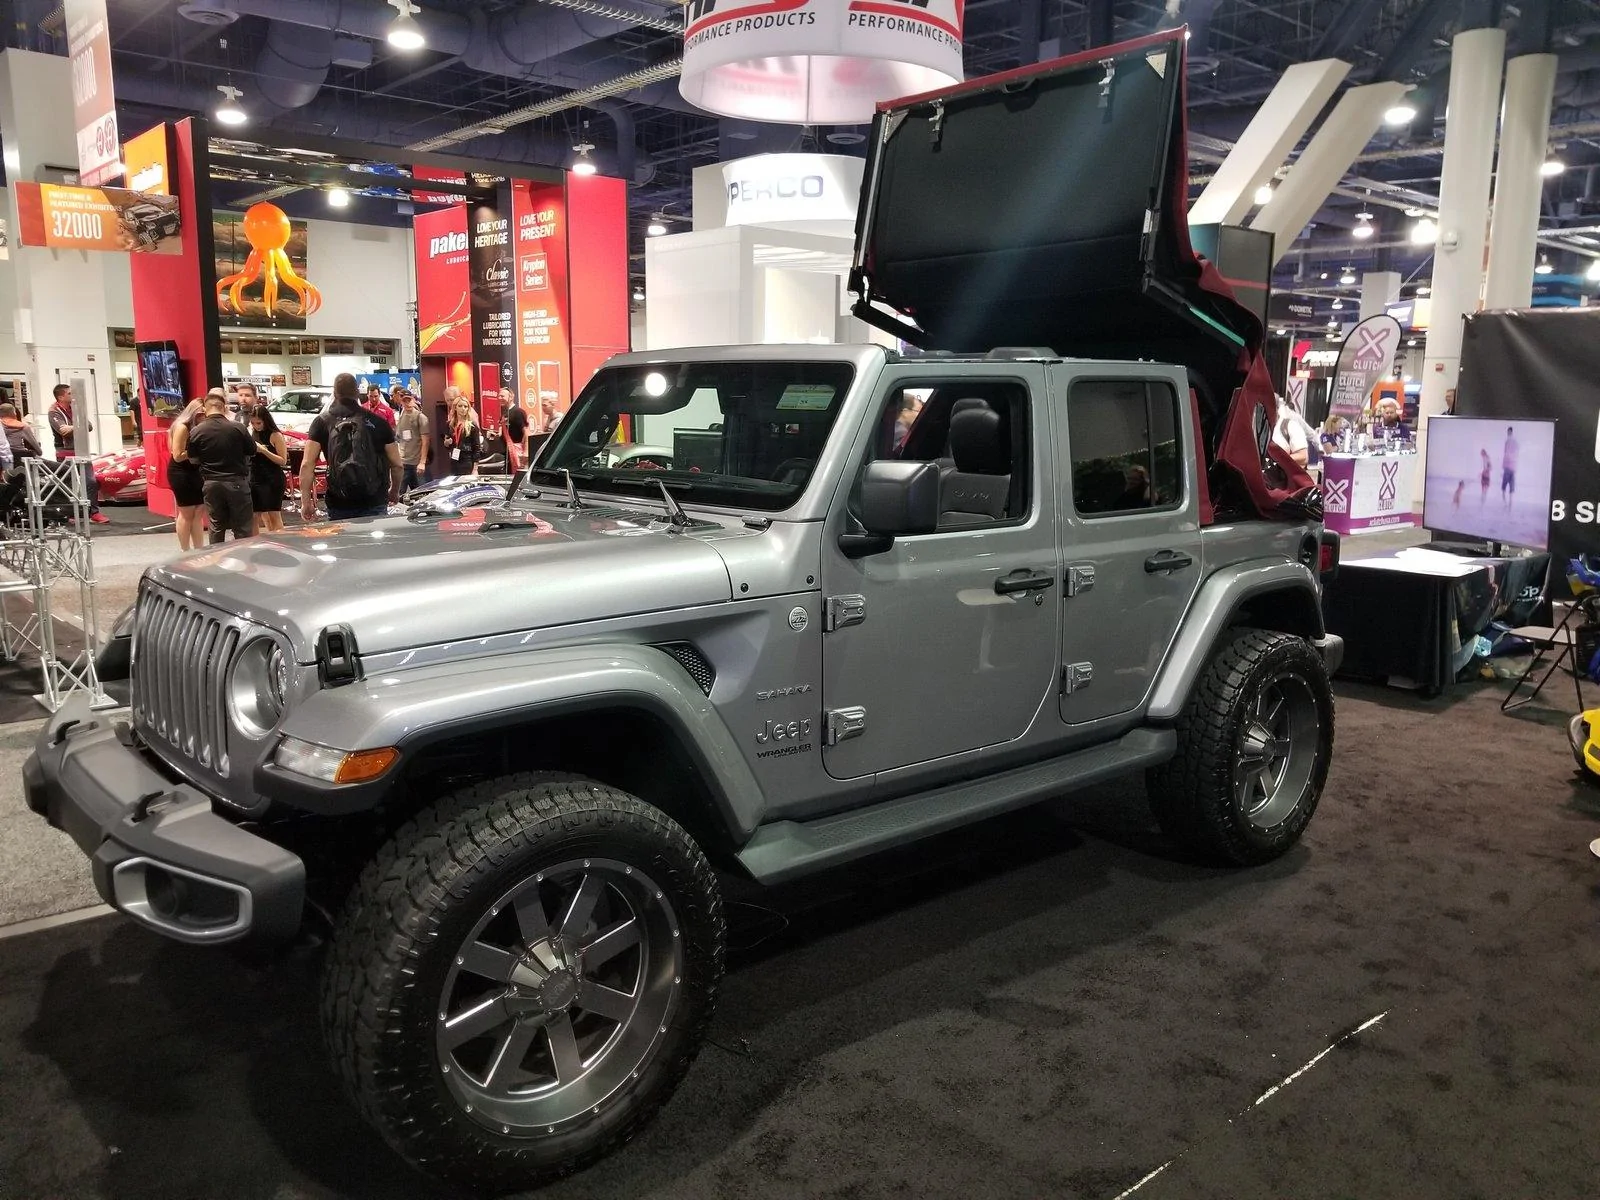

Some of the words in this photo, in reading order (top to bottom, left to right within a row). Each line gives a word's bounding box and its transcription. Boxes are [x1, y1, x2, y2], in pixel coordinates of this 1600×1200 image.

[735, 12, 816, 33] PRODUCTS
[848, 13, 943, 43] PERFORMANCE
[728, 175, 824, 206] PERCO
[51, 210, 102, 239] 32000
[520, 213, 536, 226] LOVE
[537, 209, 554, 222] YOUR
[476, 222, 492, 234] LOVE
[491, 219, 508, 230] YOUR
[520, 222, 556, 241] PRESENT
[474, 231, 508, 248] HERITAGE
[486, 259, 509, 281] Classic
[525, 274, 544, 286] Series
[483, 321, 512, 329] LUBRICANTS
[499, 329, 512, 337] YOUR
[483, 338, 501, 346] VINTAGE
[502, 337, 512, 345] CAR
[1353, 360, 1383, 371] CLUTCH
[1339, 376, 1366, 387] CLUTCH
[1324, 503, 1346, 513] CLUTCH
[756, 684, 812, 701] SAHARA
[756, 718, 812, 744] Jeep
[756, 743, 812, 759] WRANGLER
